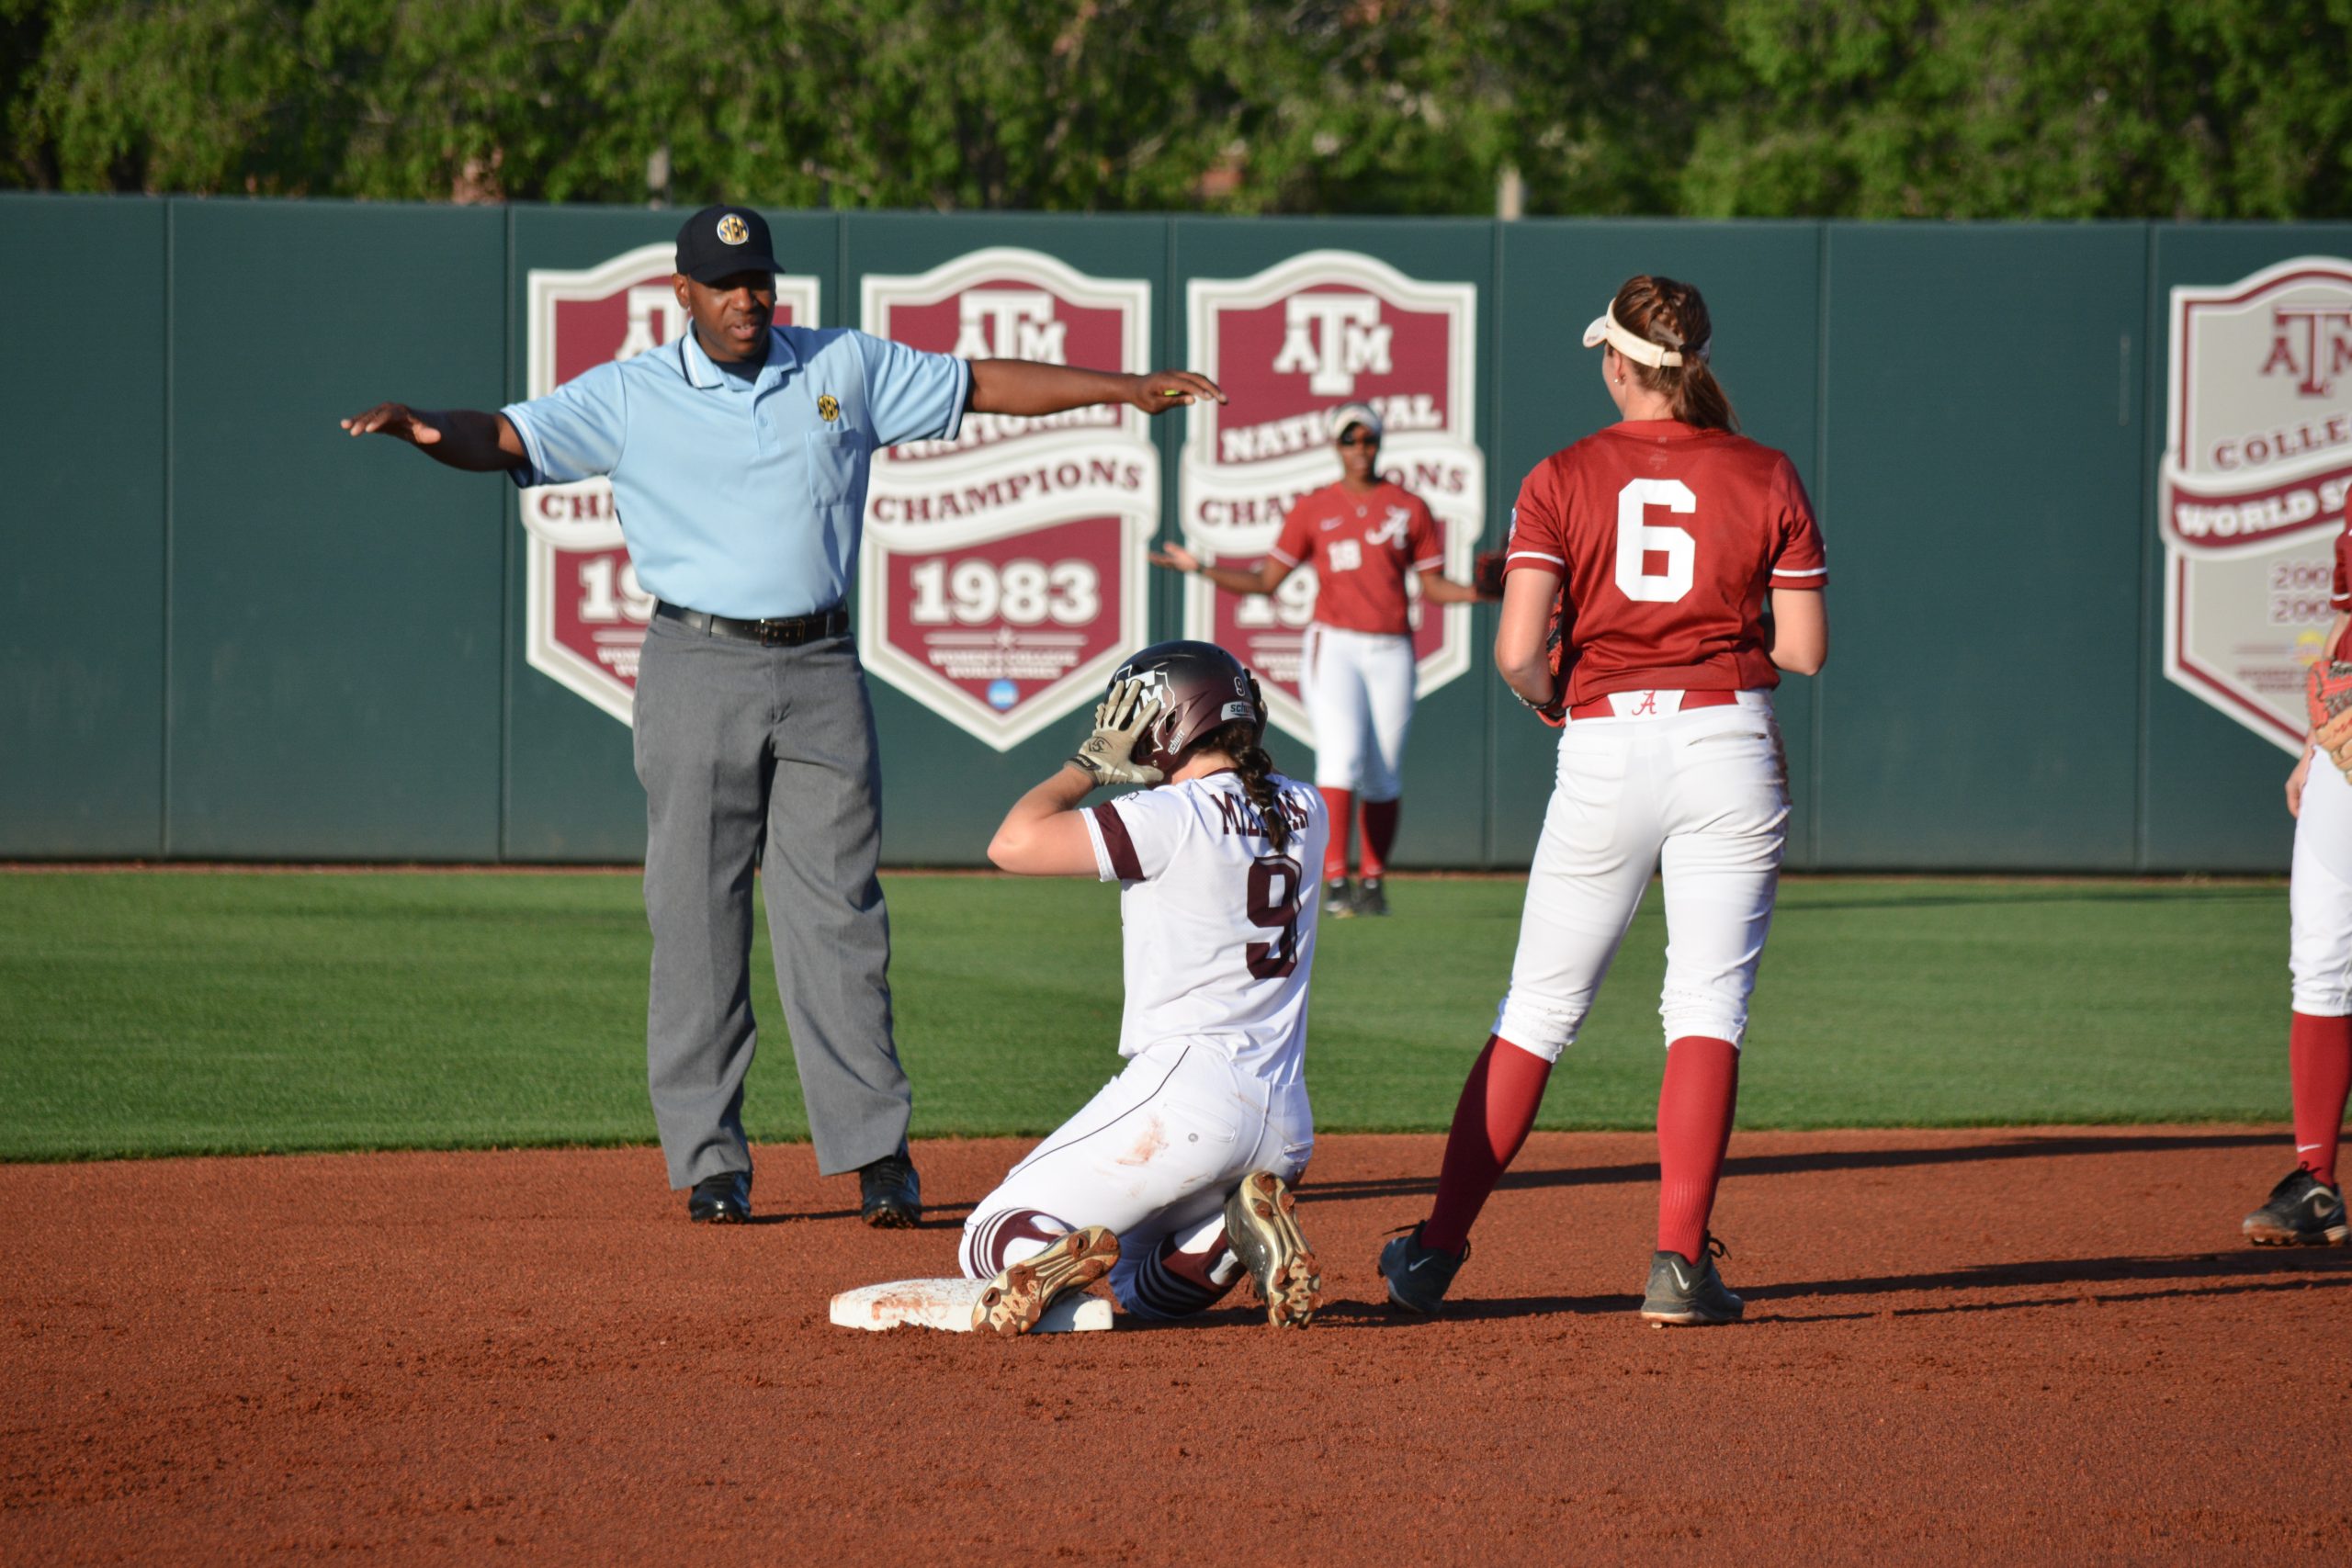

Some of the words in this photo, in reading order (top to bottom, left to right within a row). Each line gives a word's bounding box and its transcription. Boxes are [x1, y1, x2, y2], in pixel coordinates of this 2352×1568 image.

[720, 216, 747, 243] SEC
[818, 395, 839, 422] SEC
[1222, 395, 1442, 461] NATIAL
[2215, 417, 2352, 467] COLLE
[873, 460, 1141, 522] CHAMPIONS
[1199, 462, 1465, 526] CHAONS
[2175, 489, 2319, 536] WORLD
[1615, 478, 1696, 603] 6
[910, 558, 1099, 625] 1983
[2275, 565, 2333, 591] 200
[2275, 598, 2335, 624] 200
[1234, 676, 1246, 696] 9
[1246, 854, 1302, 980] 9
